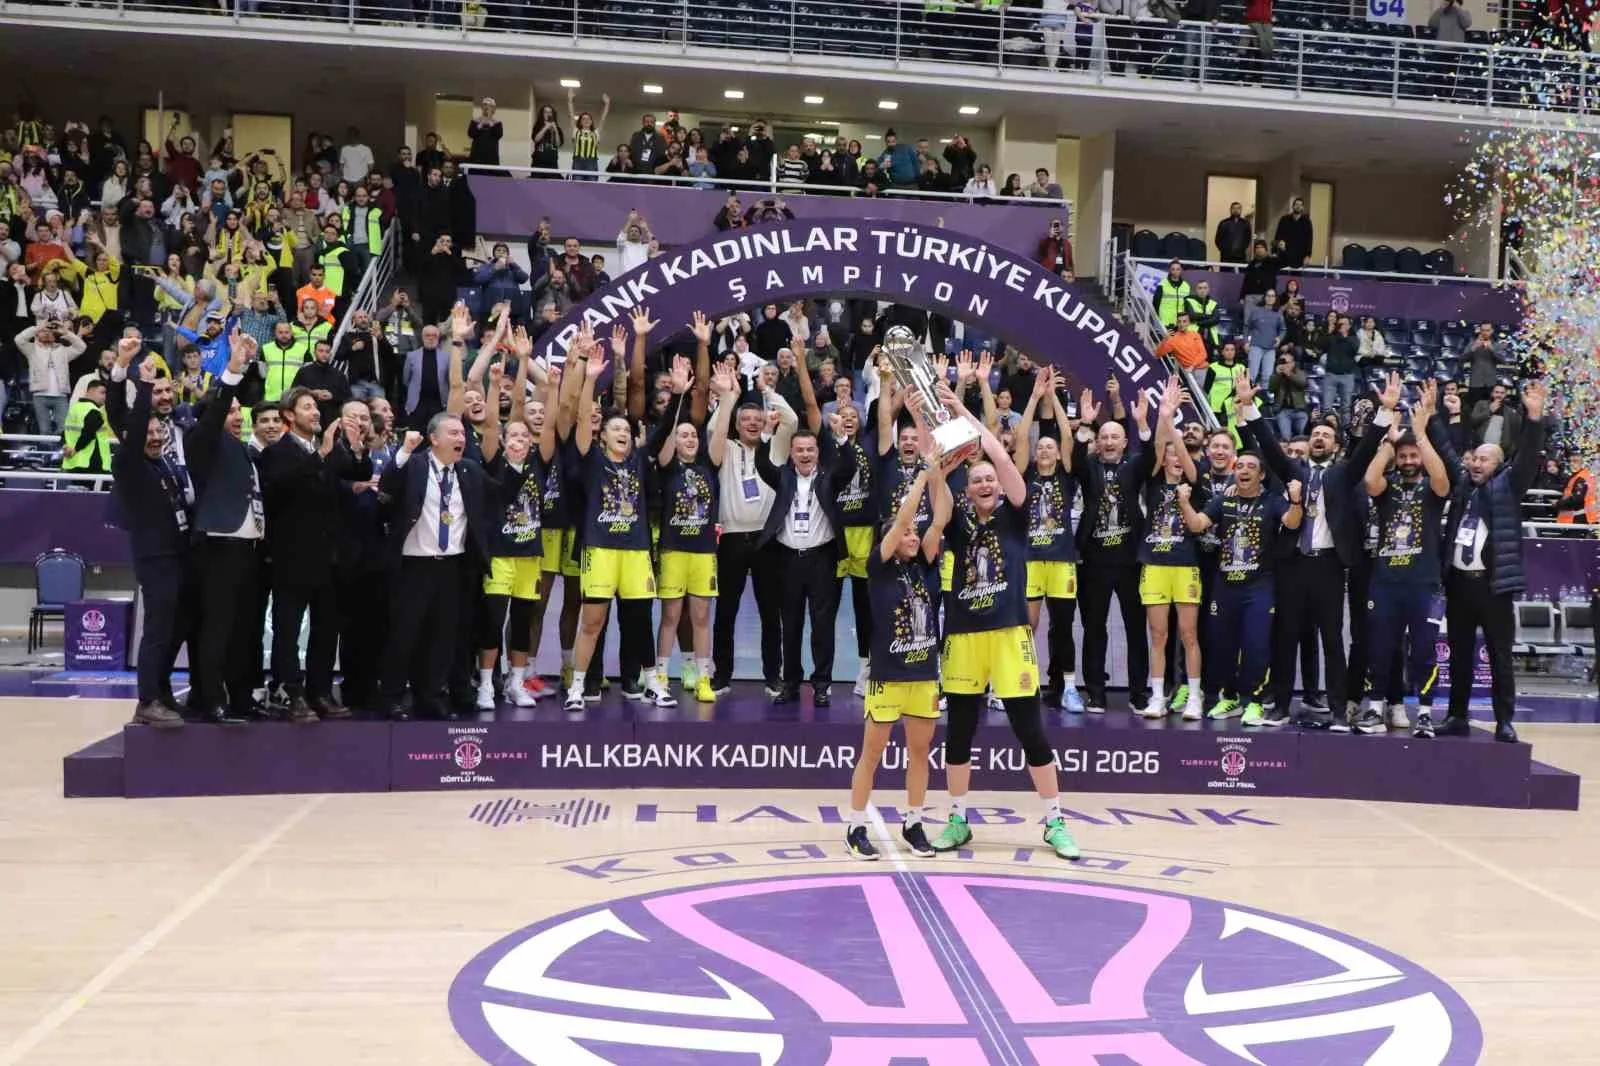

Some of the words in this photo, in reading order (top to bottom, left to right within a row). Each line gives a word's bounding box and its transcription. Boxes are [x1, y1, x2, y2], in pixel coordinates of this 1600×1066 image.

[1370, 0, 1404, 17] G4
[728, 264, 989, 316] ŞAMPİYON
[660, 227, 858, 286] KADINLAR
[871, 227, 1032, 292] TÜRKİYE
[1033, 278, 1150, 383] KUPASI
[957, 581, 1009, 602] Champions
[889, 635, 938, 654] Champion
[541, 744, 704, 768] HALKBANK
[711, 745, 855, 769] KADINLAR
[881, 741, 982, 771] ÜKİE
[989, 747, 1088, 772] KUASI
[1095, 750, 1160, 774] 2026
